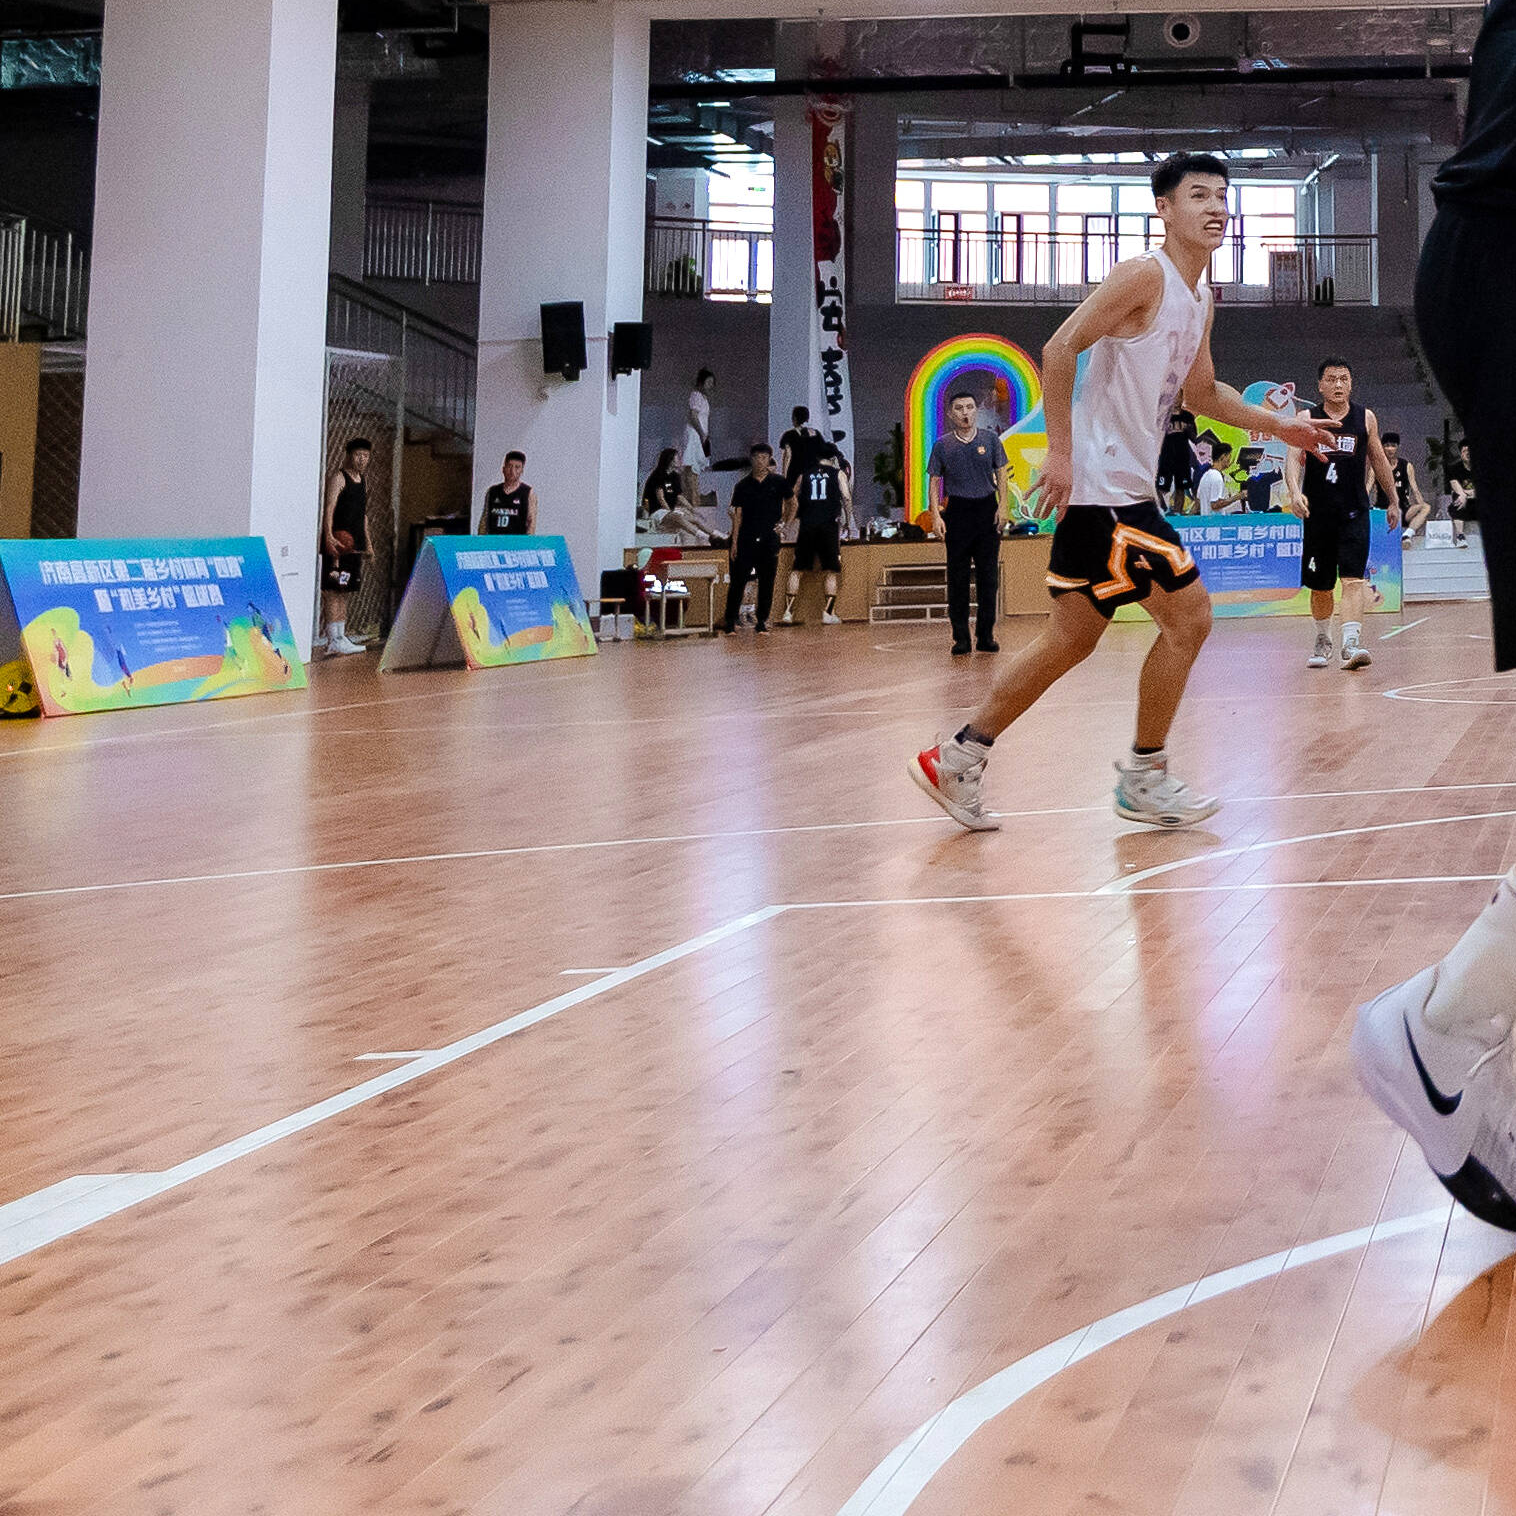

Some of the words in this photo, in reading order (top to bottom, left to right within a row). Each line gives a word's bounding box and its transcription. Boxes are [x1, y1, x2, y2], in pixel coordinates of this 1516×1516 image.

[1325, 462, 1338, 484] 4
[810, 478, 828, 501] 11
[496, 515, 510, 527] 10
[1308, 556, 1317, 572] 4
